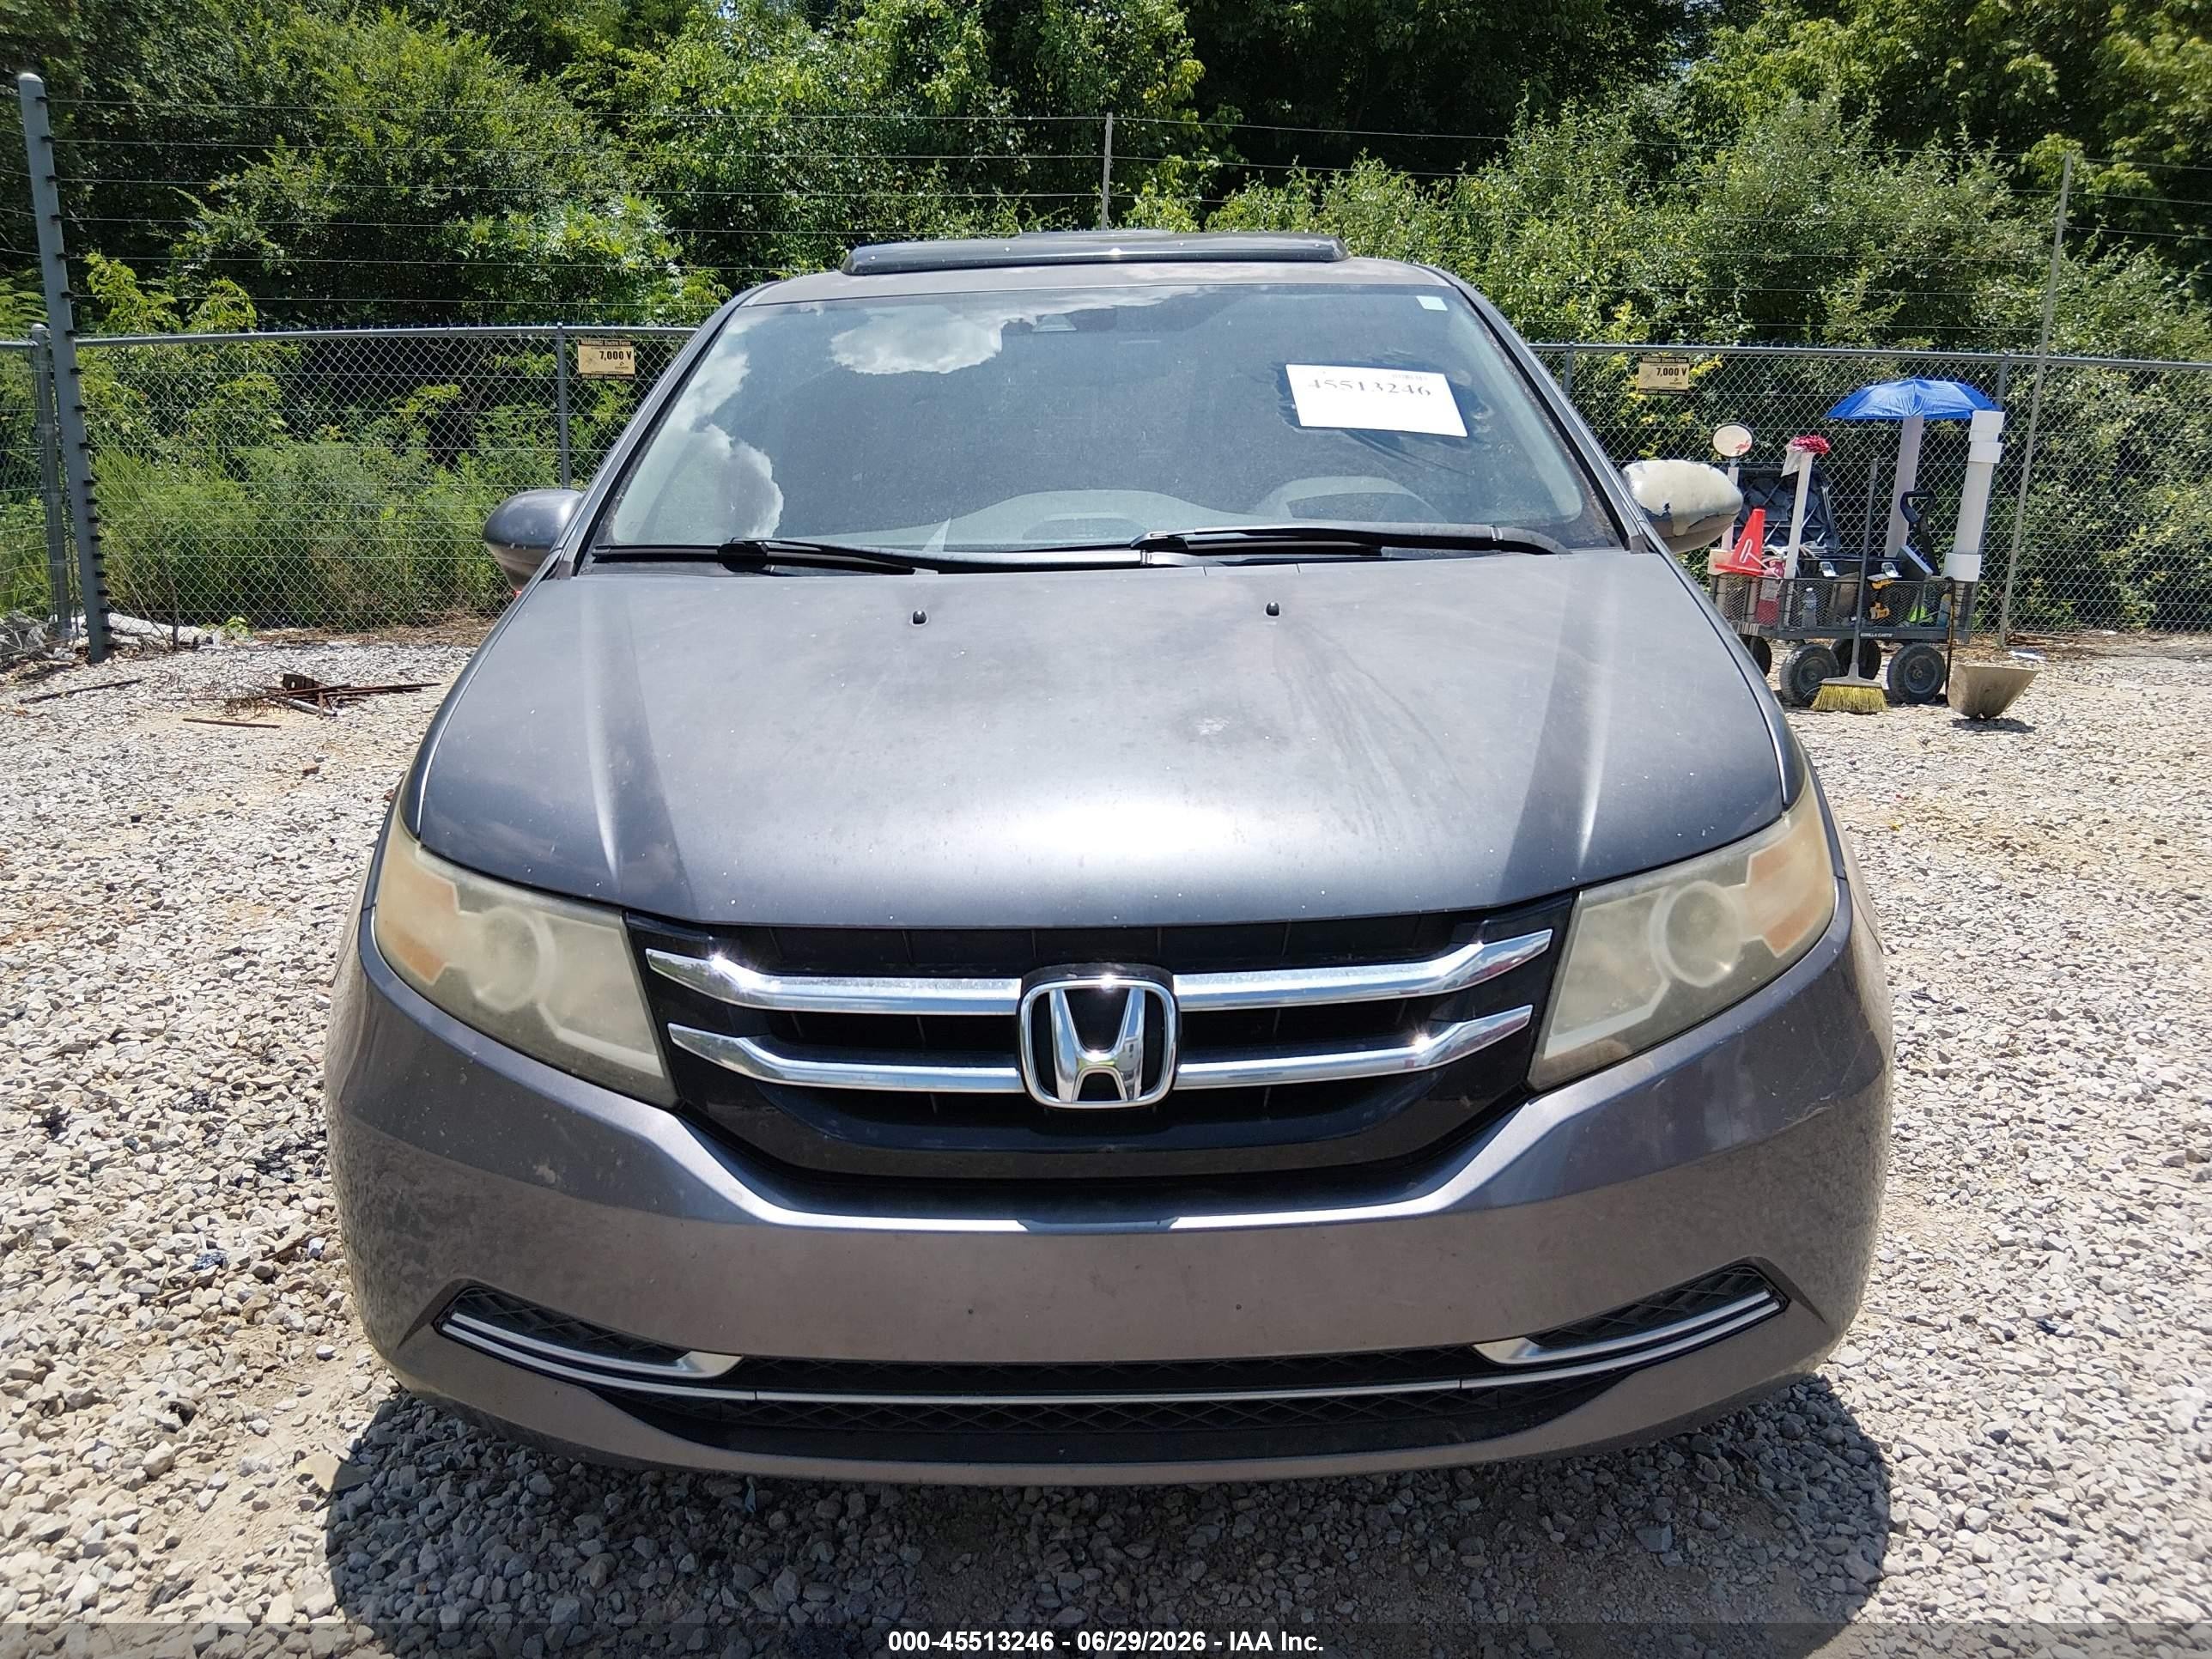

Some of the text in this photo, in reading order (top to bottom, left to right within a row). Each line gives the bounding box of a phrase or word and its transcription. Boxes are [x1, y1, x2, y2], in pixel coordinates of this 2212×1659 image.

[599, 350, 632, 361] 7,000 V
[1656, 367, 1687, 377] 7,000 V
